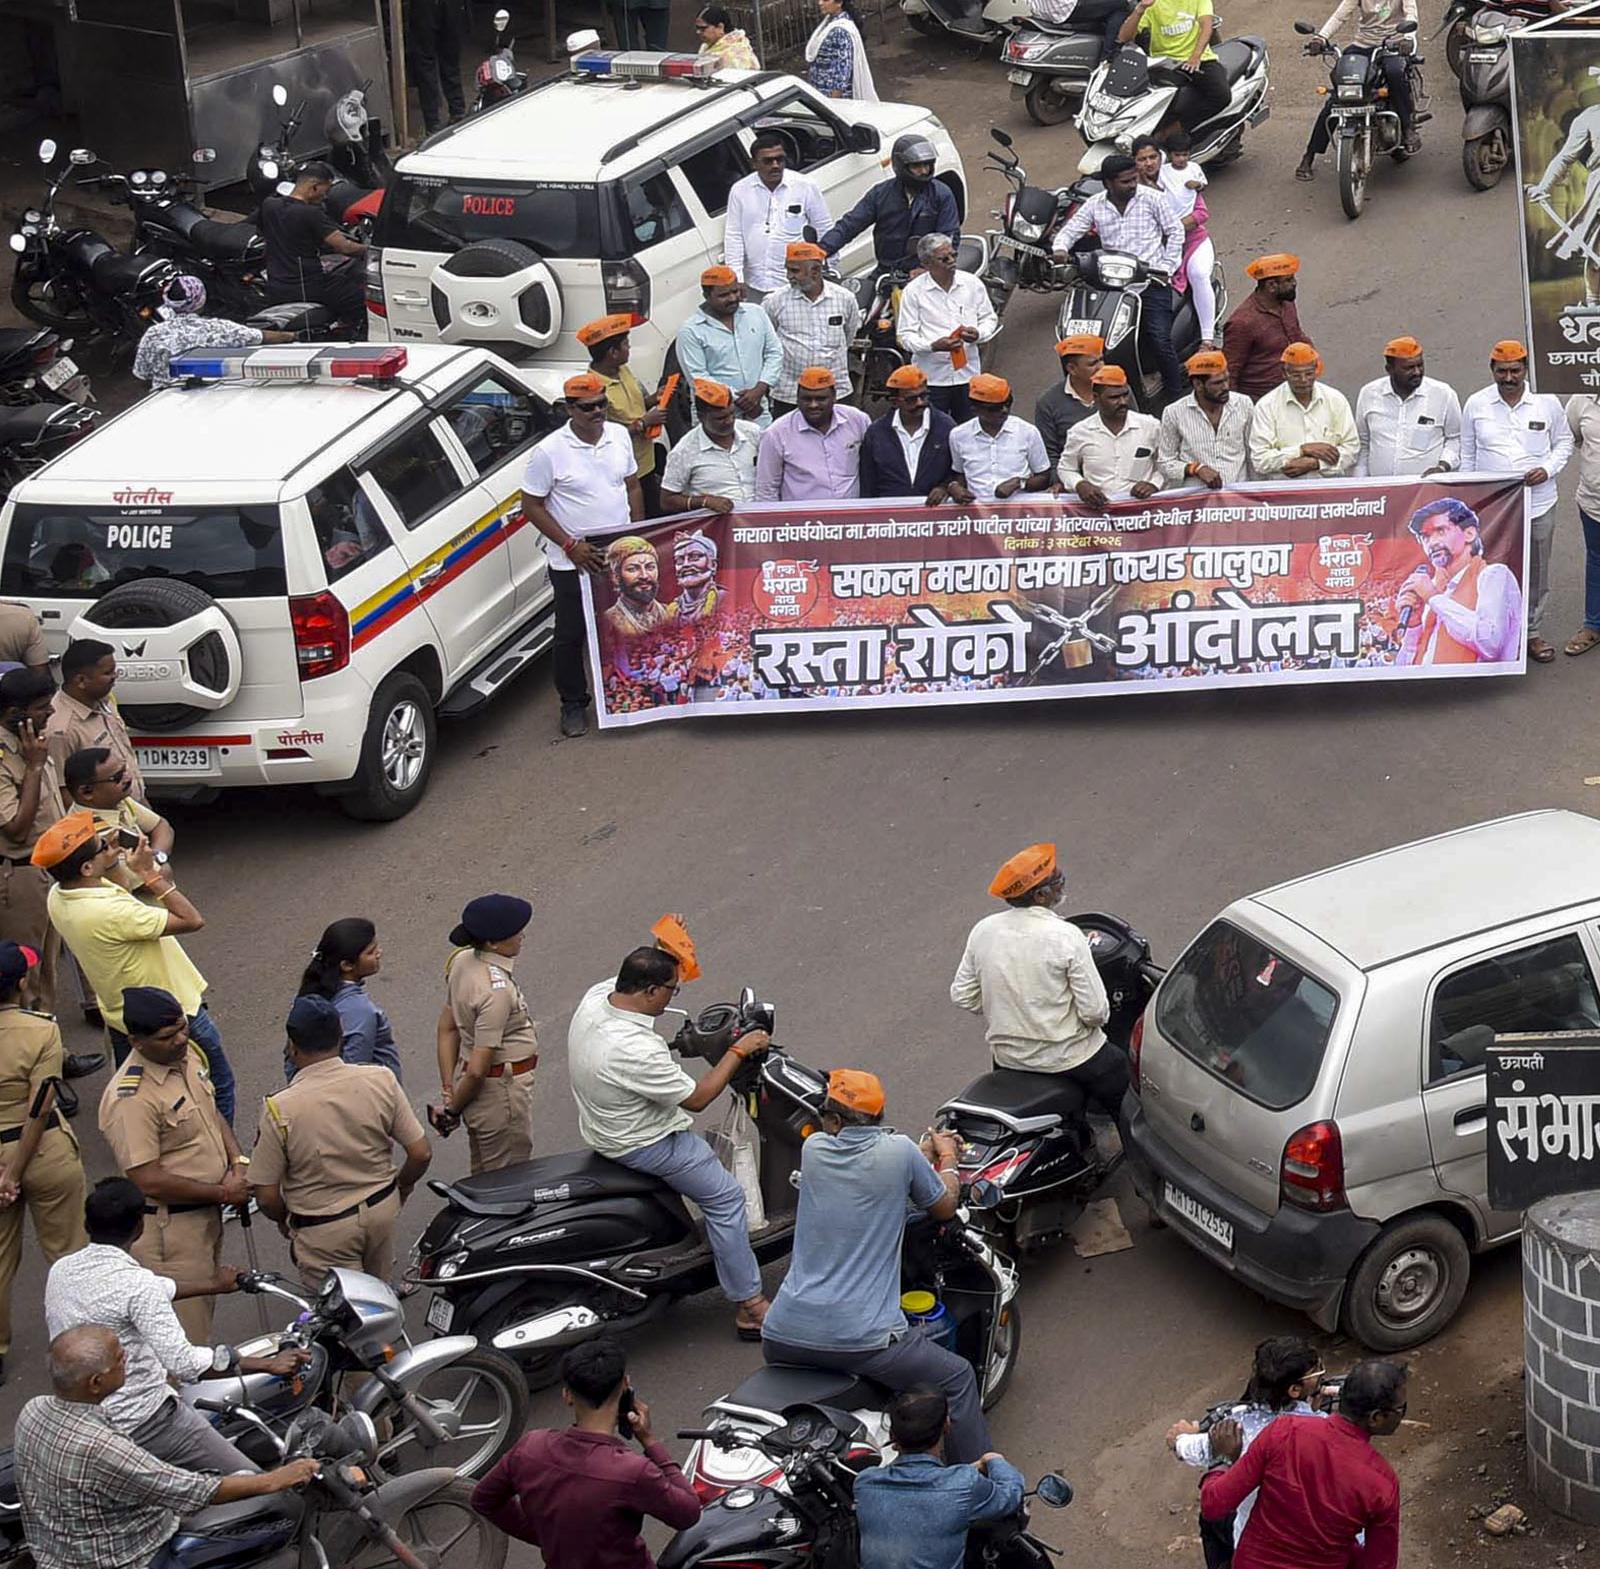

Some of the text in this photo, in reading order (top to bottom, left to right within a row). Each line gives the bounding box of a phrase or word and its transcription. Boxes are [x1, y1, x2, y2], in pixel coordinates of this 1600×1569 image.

[462, 195, 516, 216] POLICE
[112, 487, 174, 504] पोलीस
[732, 526, 774, 544] मराठा
[936, 515, 972, 538] जरांगे
[973, 514, 1013, 535] पाटील
[1015, 513, 1052, 534] यांच्या
[1152, 507, 1193, 528] येथील
[1194, 505, 1247, 524] आमरण
[1248, 500, 1319, 523] उपोषणाच्या
[1319, 495, 1387, 520] समर्थनार्थ
[106, 524, 173, 549] POLICE
[1003, 534, 1123, 551] दिनांक ३ सप्टेंबर २०२६
[1319, 549, 1363, 567] मराठा
[829, 543, 1293, 600] सकल मराठा समाज कराड तालुका
[762, 577, 808, 594] मराठा
[1324, 575, 1355, 588] मराठा
[769, 603, 801, 617] मराठा
[754, 591, 1361, 688] रस्ता रोको आंदोलन
[115, 662, 172, 681] OLERO
[277, 730, 325, 746] पोलीस
[1498, 1055, 1545, 1071] छत्रपती
